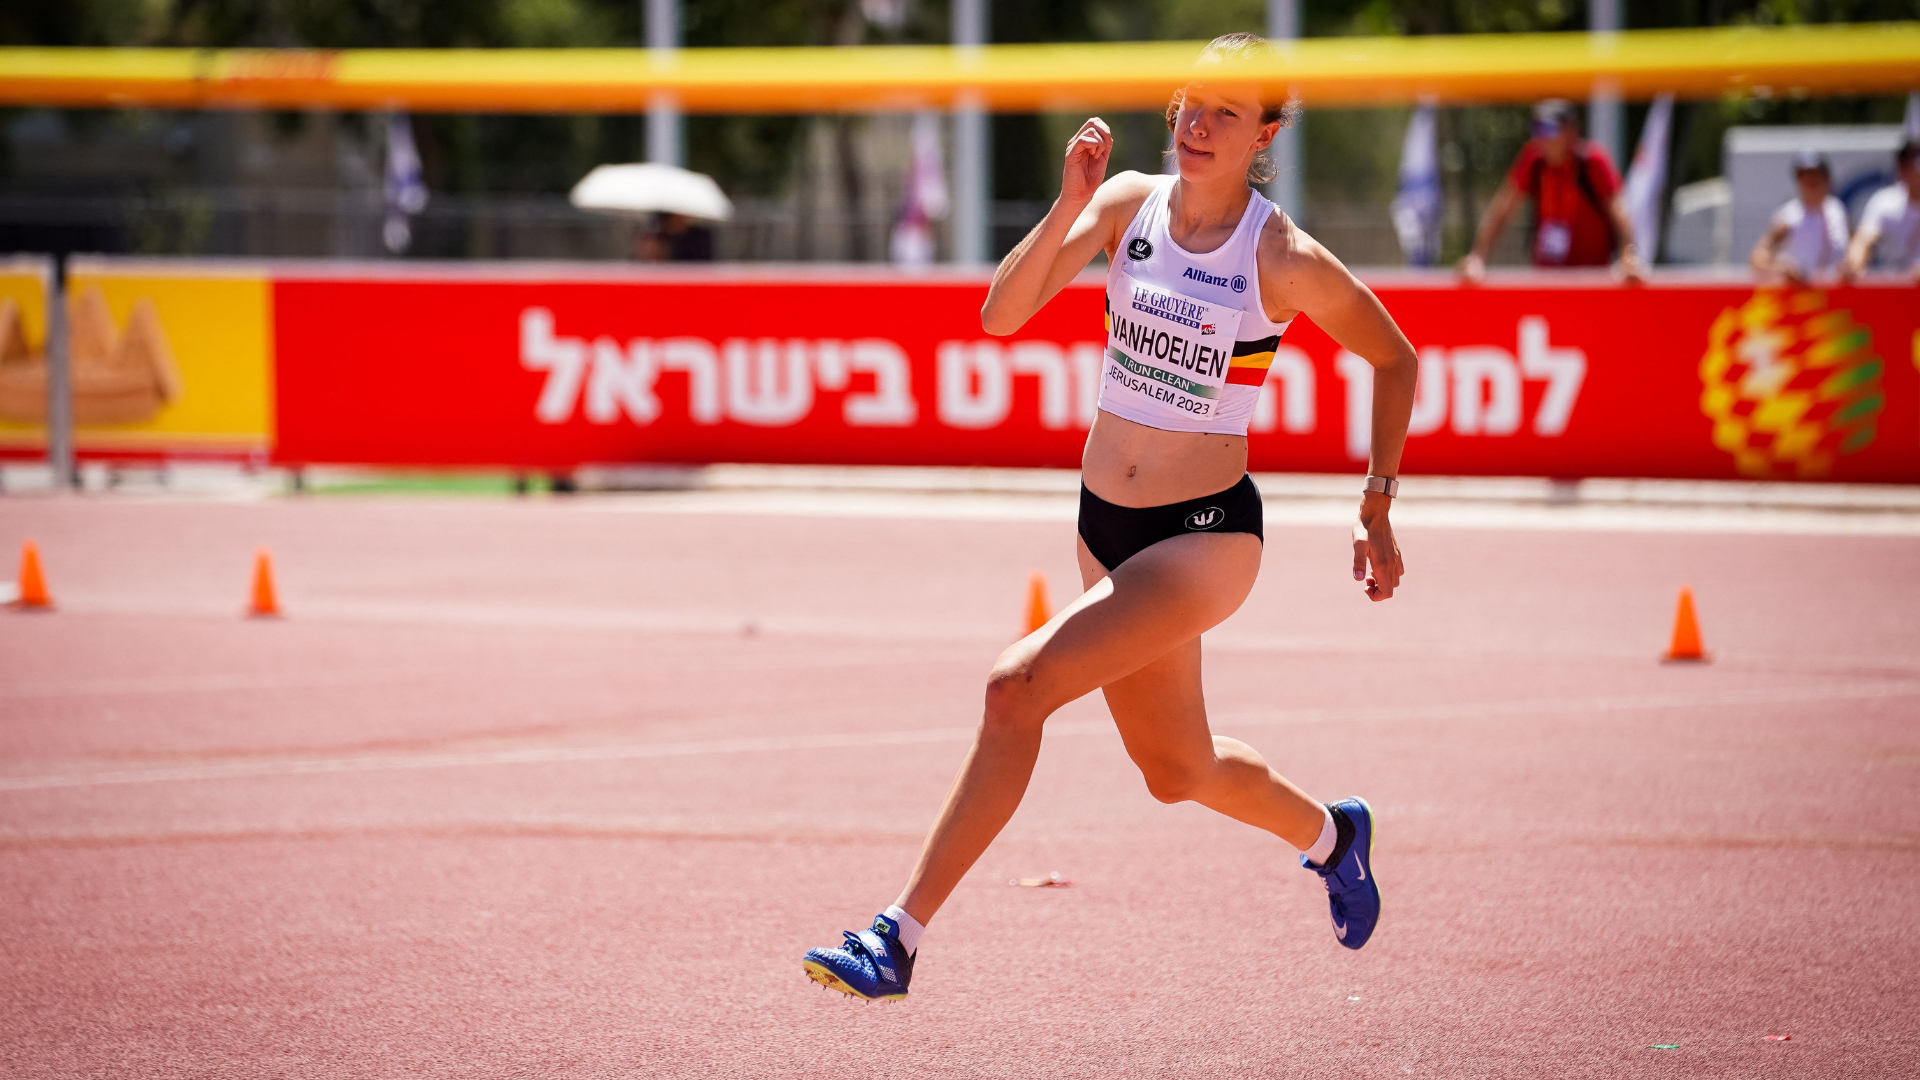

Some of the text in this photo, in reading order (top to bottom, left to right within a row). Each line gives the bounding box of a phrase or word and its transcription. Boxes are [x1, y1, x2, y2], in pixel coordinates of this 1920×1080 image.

[1134, 286, 1149, 303] LE
[1182, 266, 1229, 288] Allianz
[1134, 303, 1197, 327] SWITZERLAND
[1111, 311, 1227, 379] VANHOEIJEN
[519, 306, 916, 426] בישראל
[1126, 359, 1151, 377] RUN
[935, 340, 1316, 432] הורט
[1108, 365, 1210, 415] JERUSALEM 2023
